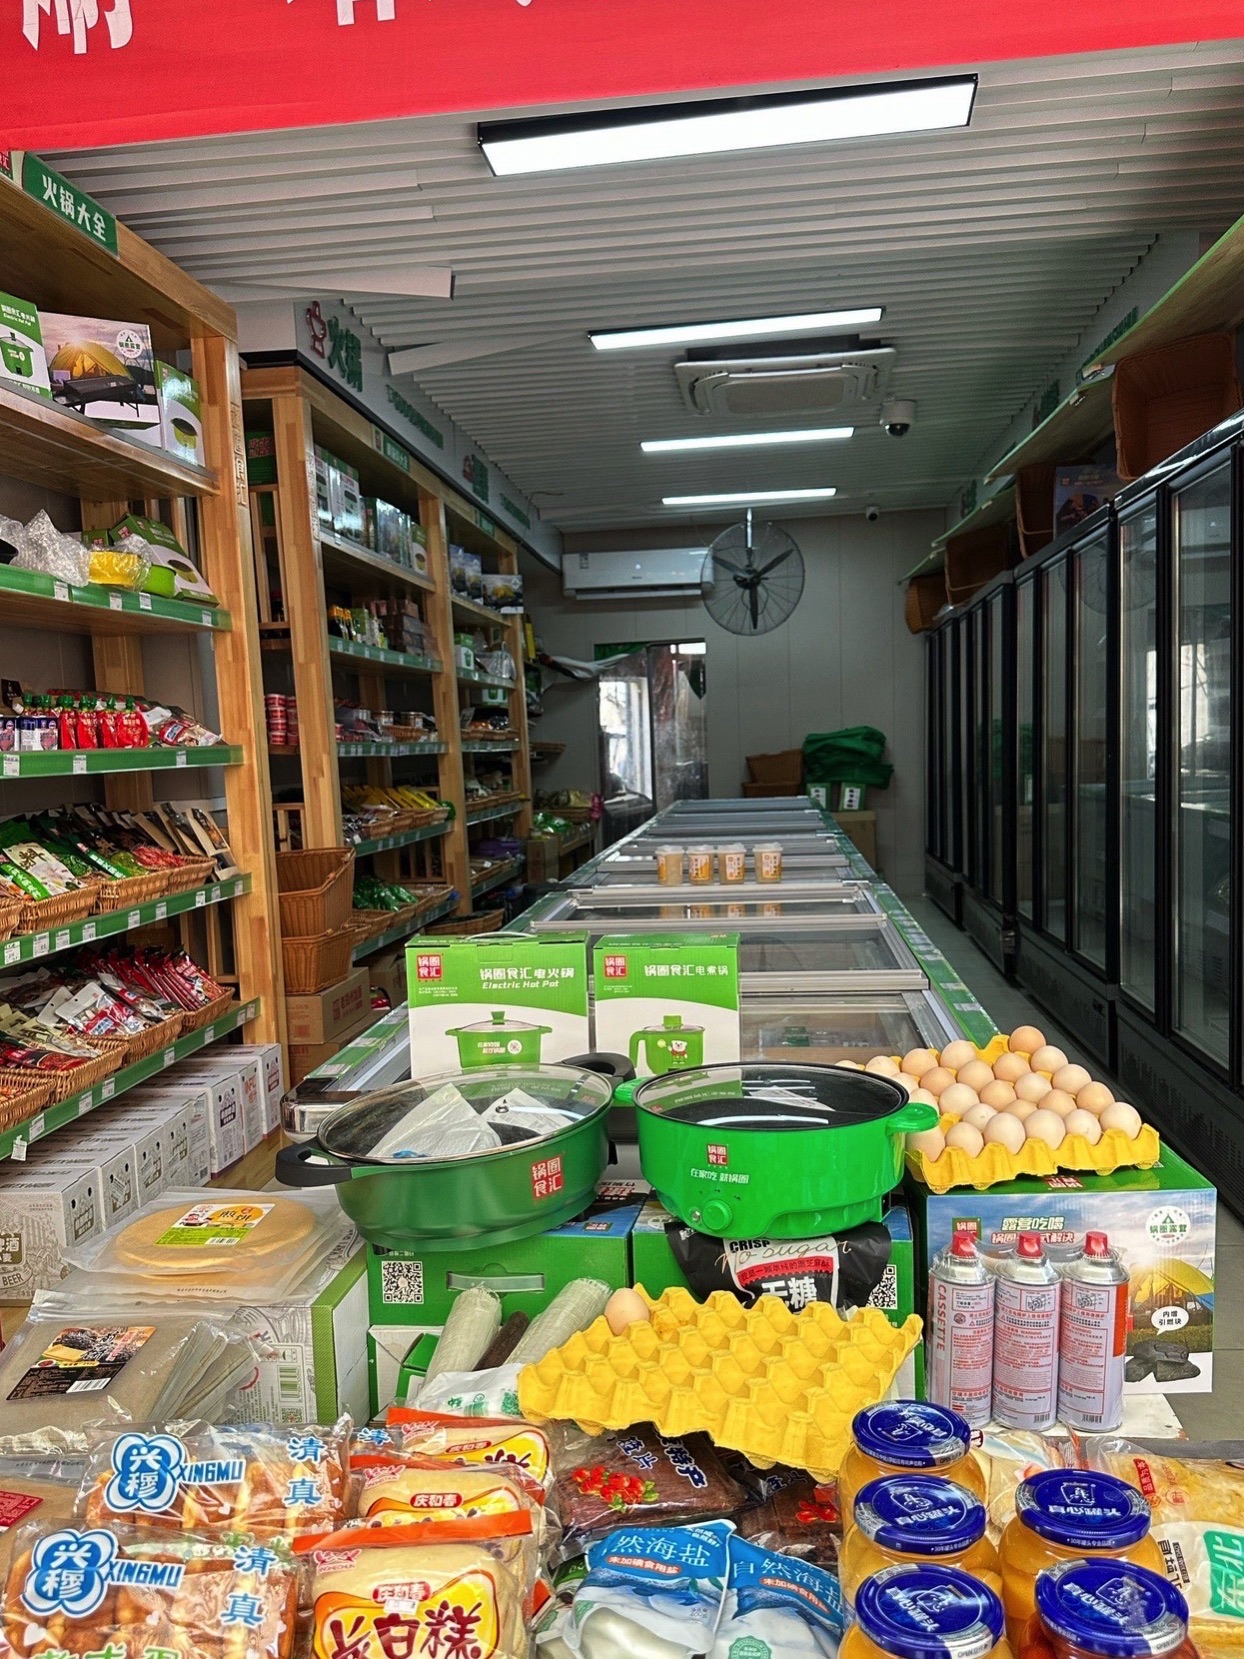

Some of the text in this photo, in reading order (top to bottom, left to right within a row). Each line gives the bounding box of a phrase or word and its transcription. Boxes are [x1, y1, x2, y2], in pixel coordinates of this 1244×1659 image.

[42, 174, 107, 241] 火锅大全
[480, 967, 575, 981] 锅圈食汇电火锅
[482, 980, 559, 990] Electric Hot Pot
[531, 1157, 562, 1181] 锅圈
[533, 1174, 563, 1198] 食汇
[1001, 1216, 1065, 1231] 露营吃喝
[729, 1239, 771, 1254] CRISP
[2, 1272, 24, 1286] BEER
[936, 1284, 947, 1351] CASSETTE
[125, 1447, 162, 1498] 兴穆
[177, 1460, 244, 1482] XINGMU
[284, 1437, 325, 1505] 清真
[412, 1494, 459, 1508] 庆和春
[42, 1543, 92, 1599] 兴穆
[104, 1560, 183, 1588] XINGMU
[220, 1547, 276, 1626] 清真
